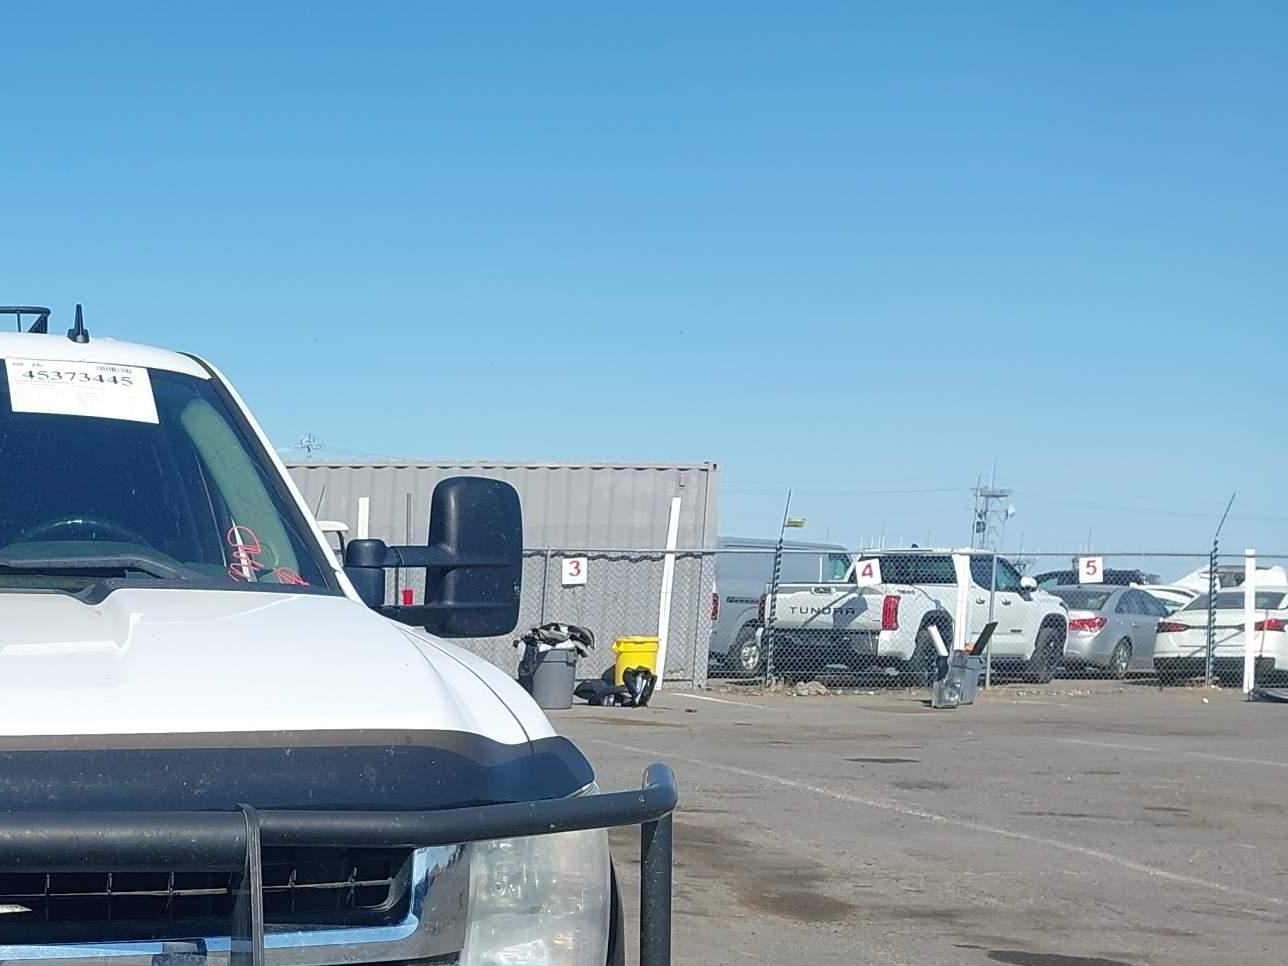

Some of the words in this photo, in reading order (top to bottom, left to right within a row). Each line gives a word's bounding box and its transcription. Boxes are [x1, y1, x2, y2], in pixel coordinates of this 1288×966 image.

[22, 370, 133, 387] 45373445
[568, 560, 581, 577] 3
[862, 563, 874, 578] 4
[1085, 559, 1097, 576] 5
[789, 606, 855, 615] TUNDRA
